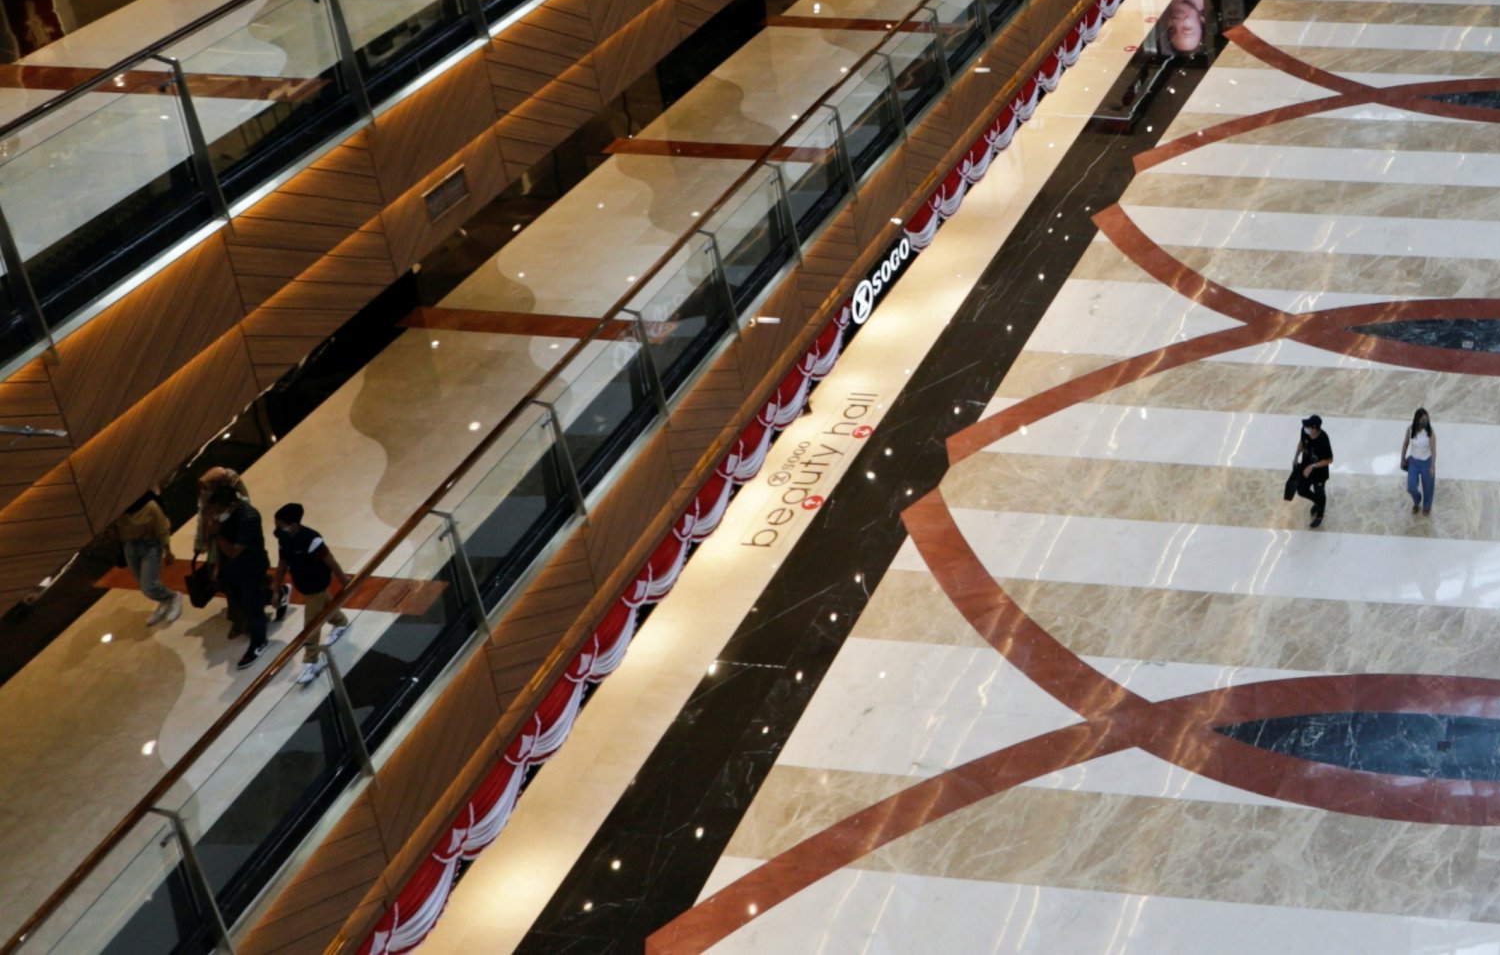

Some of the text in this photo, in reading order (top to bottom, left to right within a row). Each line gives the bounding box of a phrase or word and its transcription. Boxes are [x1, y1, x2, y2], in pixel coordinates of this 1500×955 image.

[872, 238, 909, 296] SOGO
[741, 393, 879, 547] beauty hall
[782, 441, 811, 471] SOGO
